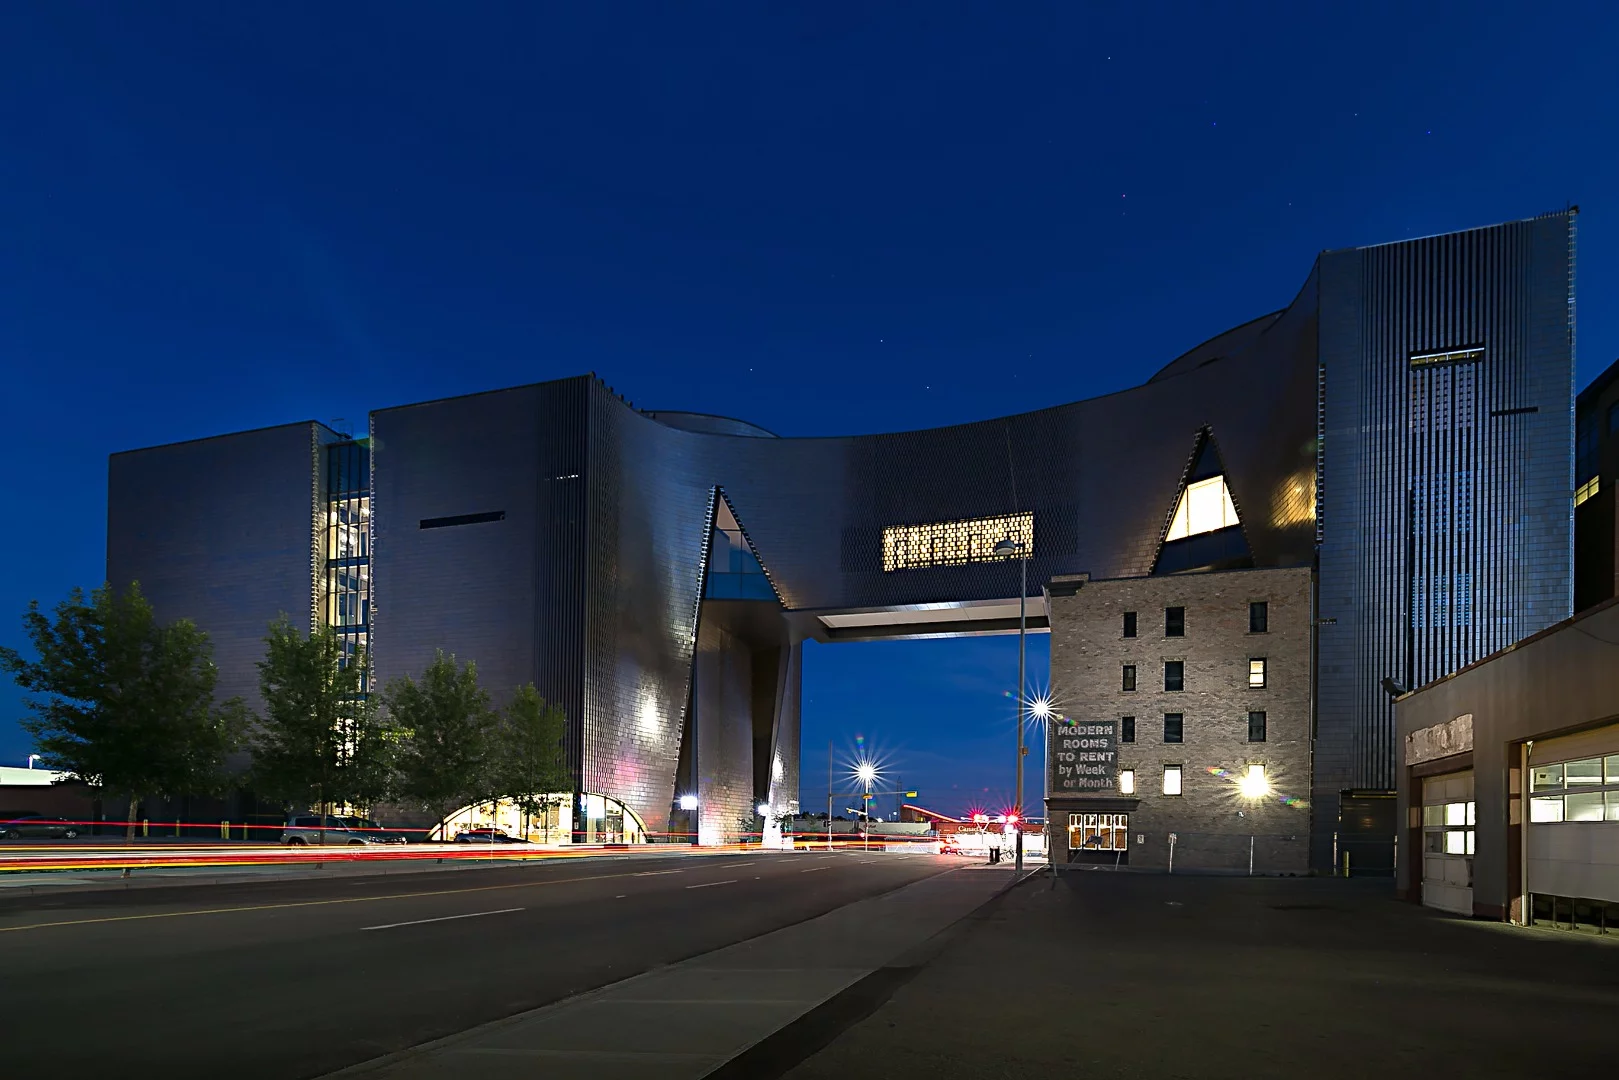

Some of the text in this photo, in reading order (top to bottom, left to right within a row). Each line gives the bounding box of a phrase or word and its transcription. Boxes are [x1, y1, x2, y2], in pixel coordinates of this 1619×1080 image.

[1058, 726, 1113, 735] MODERN
[1063, 739, 1108, 748] ROOMS
[1057, 752, 1114, 761] TO RENT
[1059, 764, 1106, 777] by Week
[1064, 778, 1112, 787] or Month
